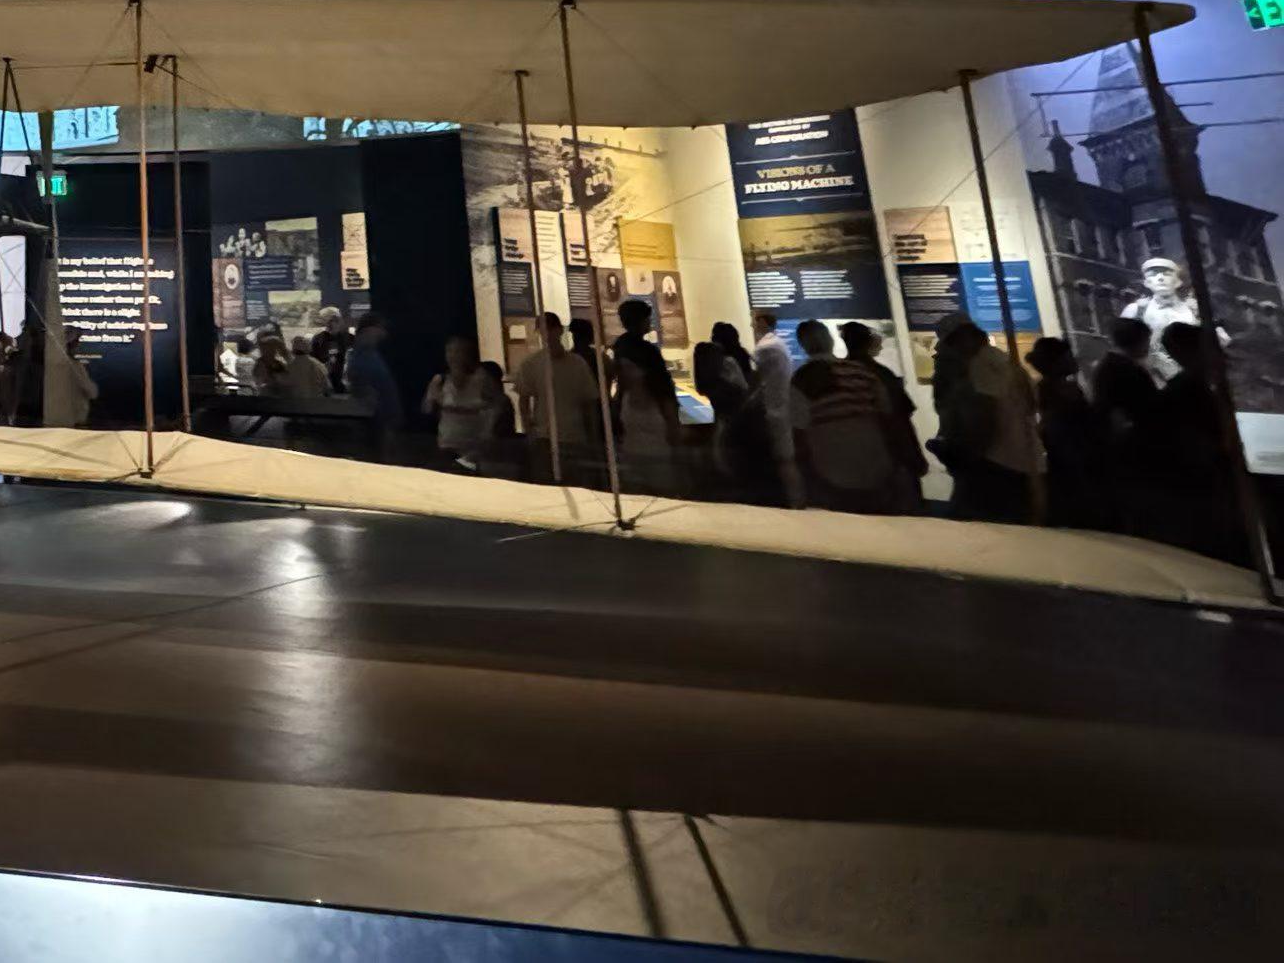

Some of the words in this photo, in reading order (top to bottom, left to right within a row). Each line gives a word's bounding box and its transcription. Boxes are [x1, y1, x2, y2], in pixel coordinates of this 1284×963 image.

[756, 166, 805, 179] VISIONS
[805, 164, 824, 176] OF
[825, 164, 836, 173] A
[744, 181, 790, 194] FLYING
[791, 176, 854, 191] MACHINE
[106, 257, 123, 265] that
